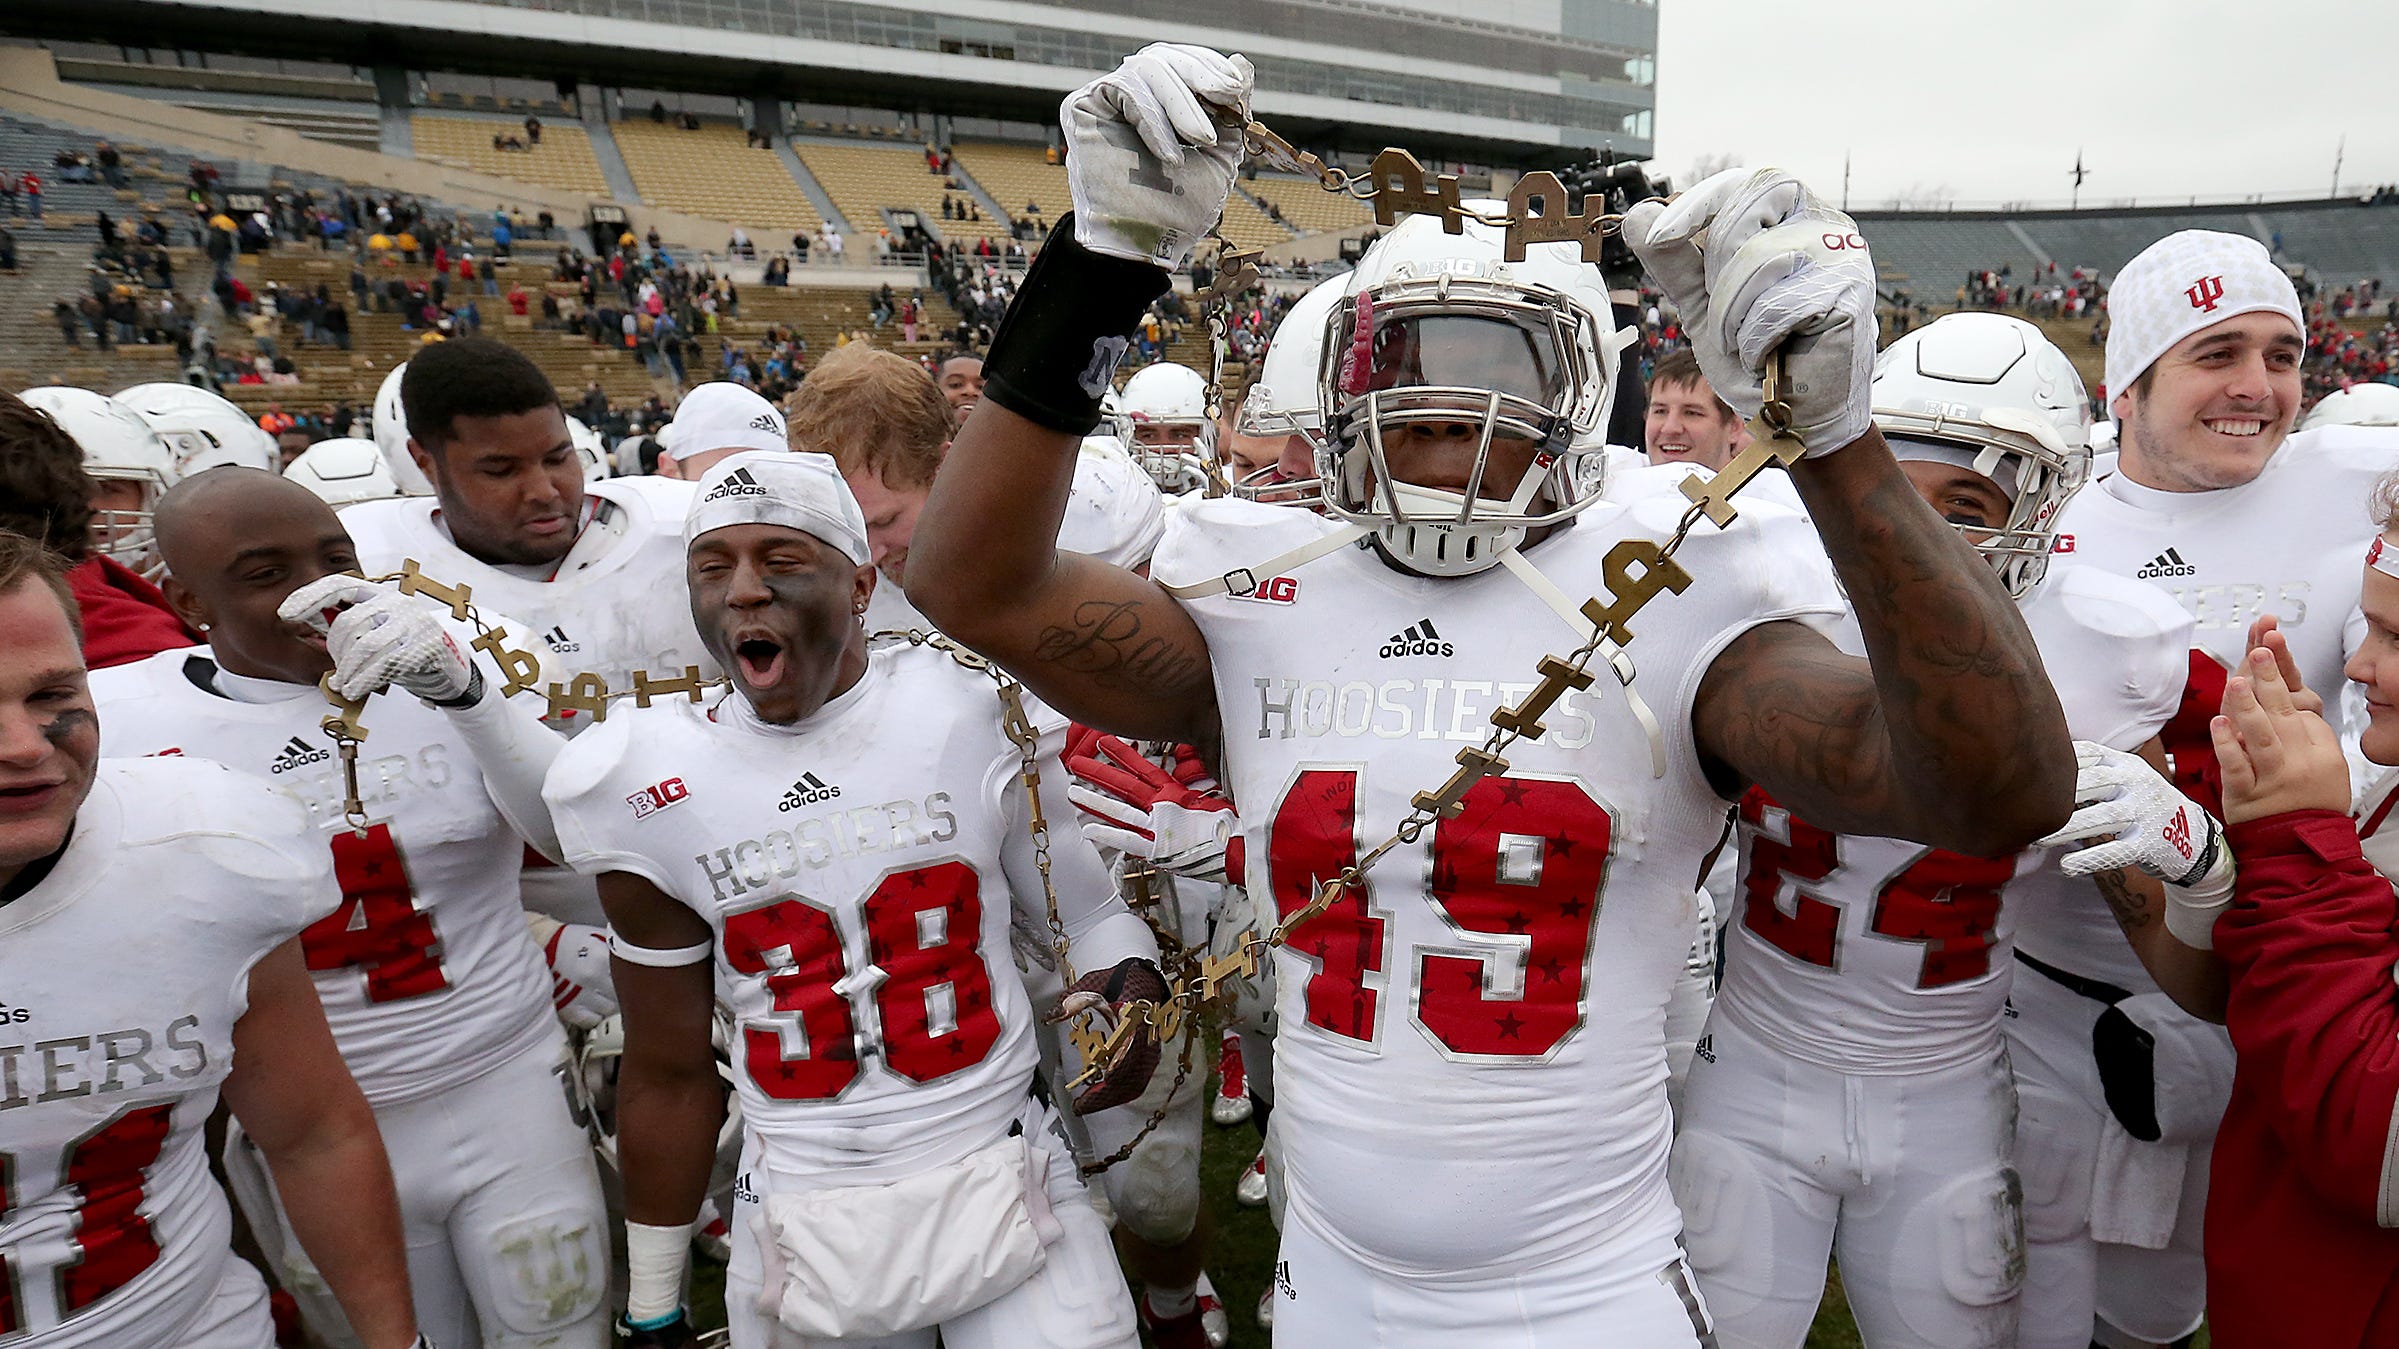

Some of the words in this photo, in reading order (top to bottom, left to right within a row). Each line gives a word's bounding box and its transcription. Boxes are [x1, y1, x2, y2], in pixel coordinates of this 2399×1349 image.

[704, 484, 767, 502] adidas
[2138, 564, 2196, 579] adidas
[1379, 639, 1454, 659] adidas
[271, 749, 330, 775] adidas
[778, 784, 841, 812] adidas
[695, 791, 959, 901] HOOSIERS
[1264, 760, 1622, 1065] 49
[721, 853, 1006, 1104] 38
